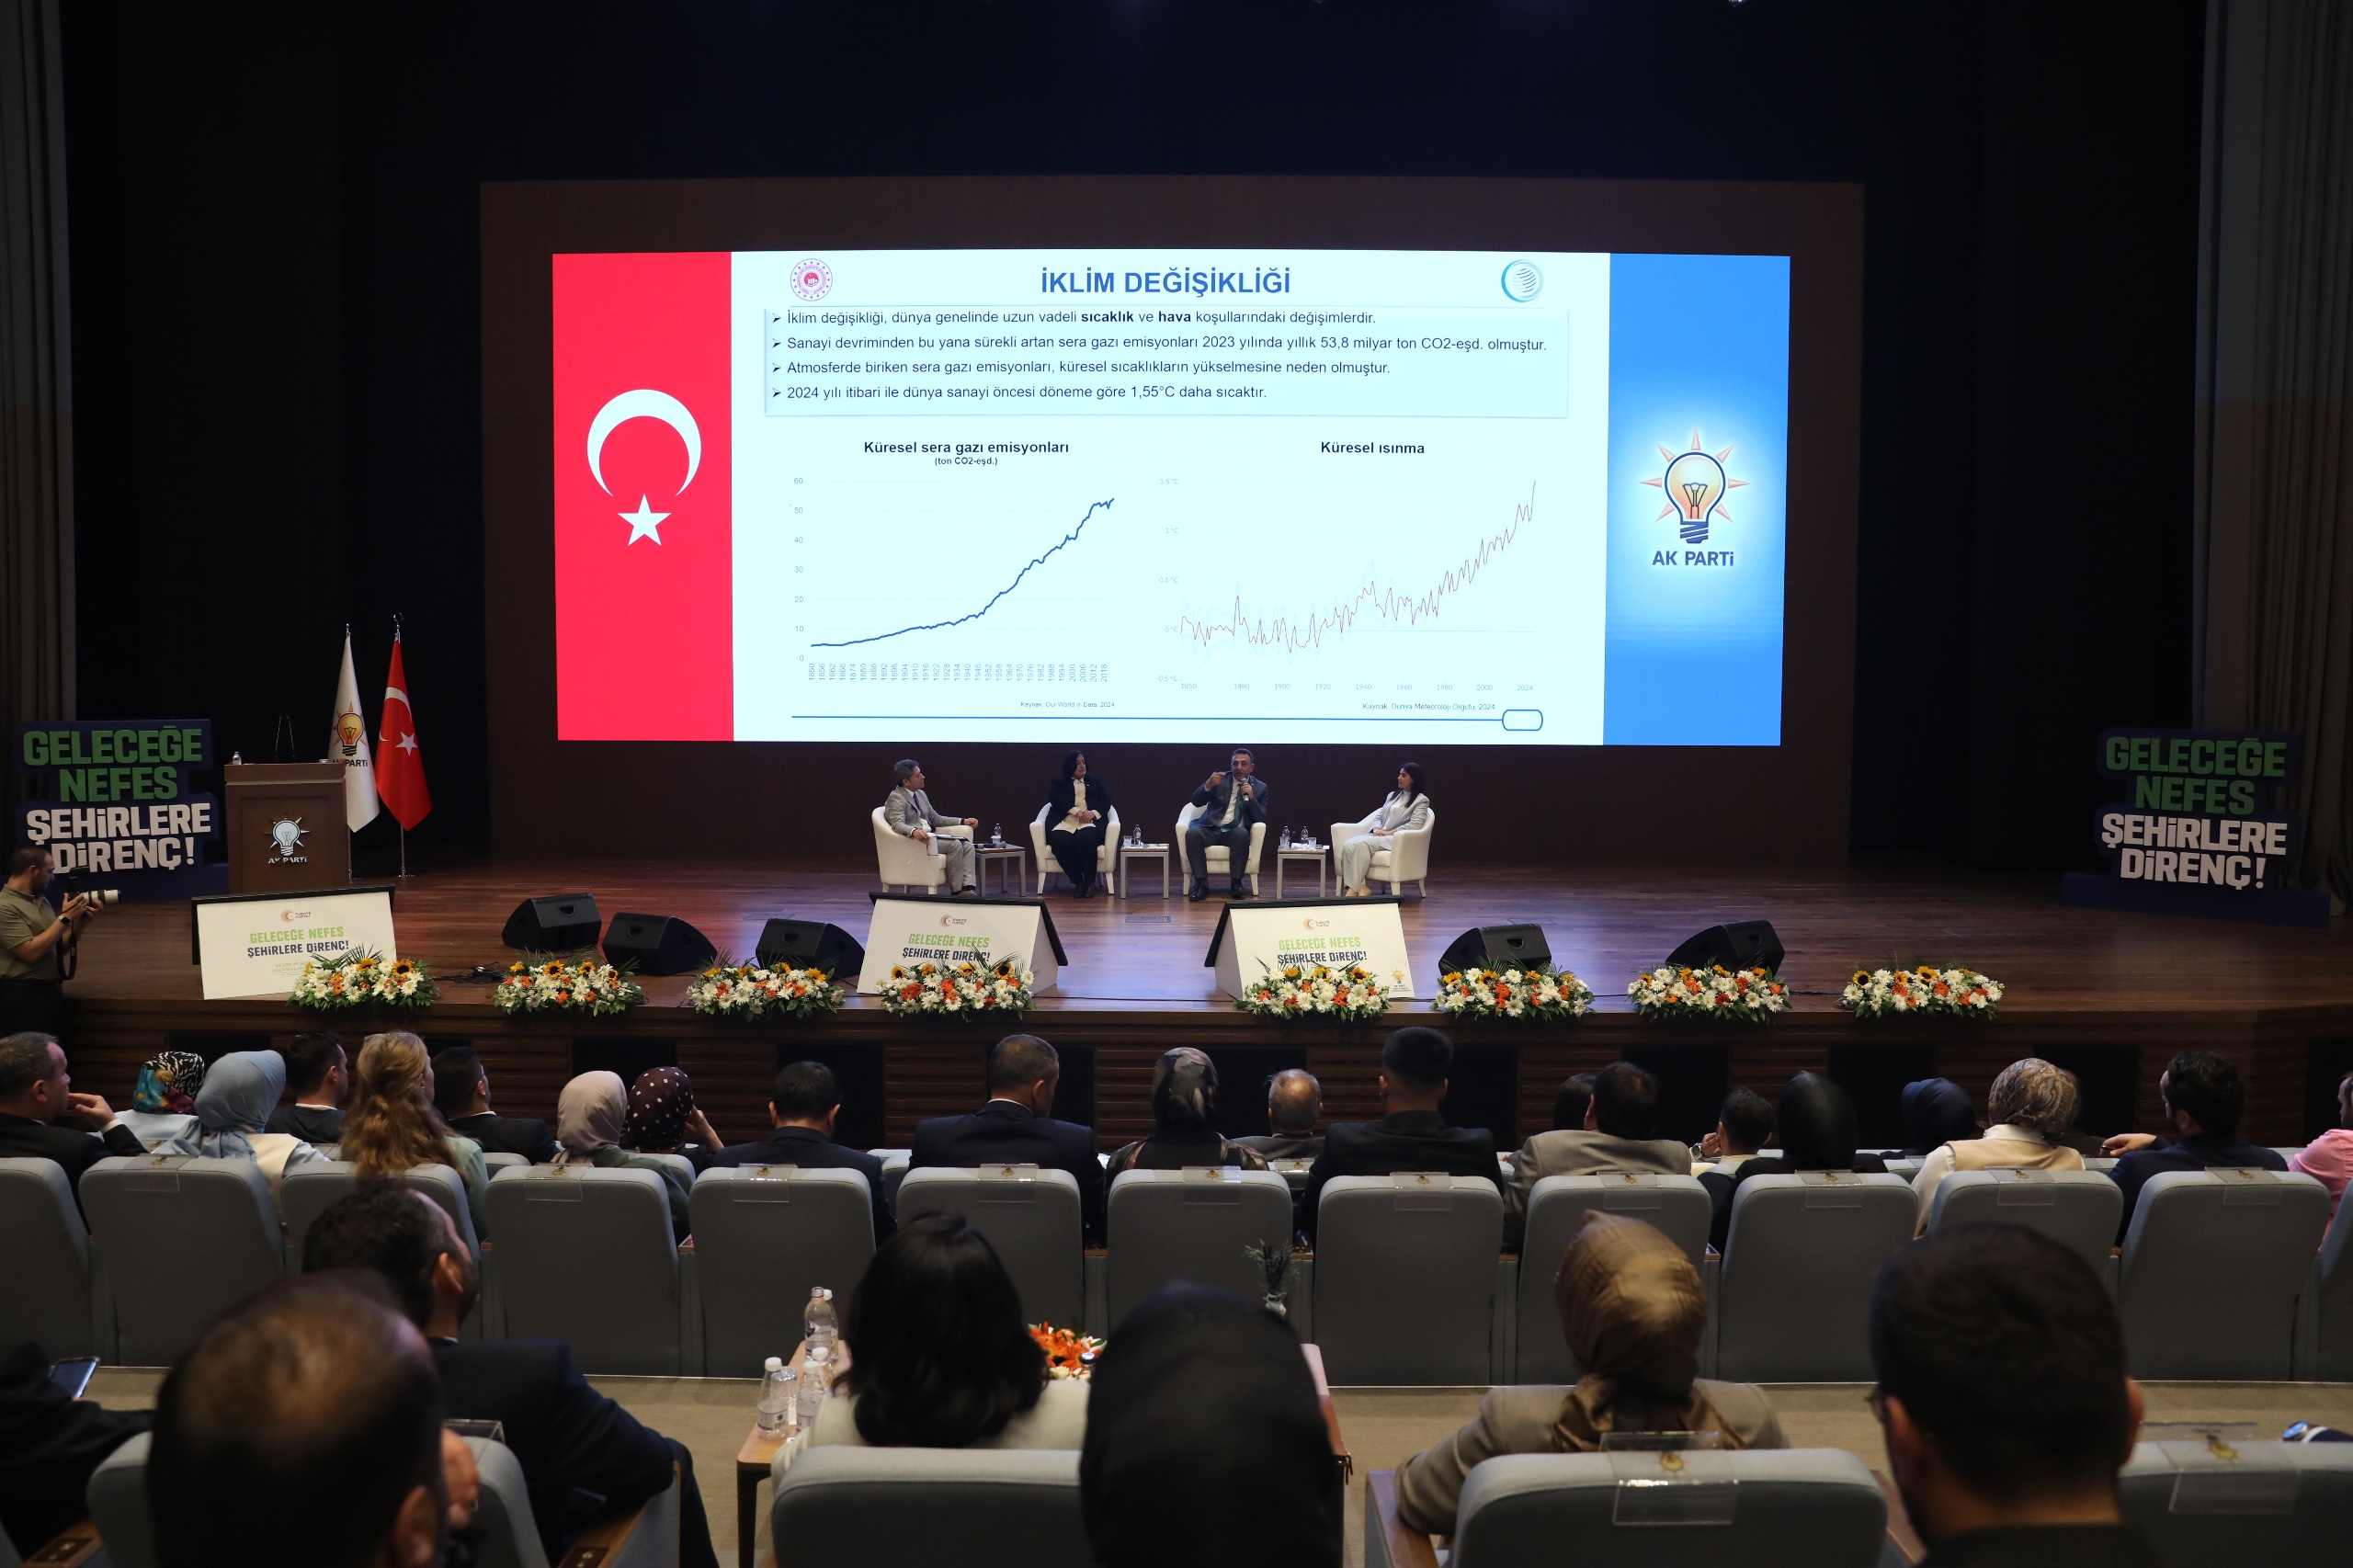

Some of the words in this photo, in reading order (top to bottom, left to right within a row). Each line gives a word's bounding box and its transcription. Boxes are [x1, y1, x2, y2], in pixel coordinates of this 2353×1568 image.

[1041, 267, 1115, 293] İKLİM
[1124, 267, 1290, 299] DEĞİŞİKLİĞİ
[788, 309, 817, 324] İklim
[821, 311, 887, 327] değişikliği,
[892, 311, 931, 326] dünya
[935, 311, 999, 325] genelinde
[1003, 312, 1035, 323] uzun
[1039, 311, 1077, 323] vadeli
[1081, 310, 1135, 323] sıcaklık
[1138, 312, 1154, 323] ve
[1158, 310, 1192, 323] hava
[1196, 311, 1286, 326] koşullarındaki
[1290, 311, 1376, 326] değişimlerdir.
[787, 336, 831, 352] Sanayi
[835, 336, 915, 348] devriminden
[918, 335, 935, 348] bu
[938, 338, 971, 351] yana
[974, 335, 1017, 348] sürekli
[1020, 335, 1054, 347] artan
[1058, 338, 1087, 347] sera
[1091, 338, 1119, 350] gazı
[1122, 335, 1198, 350] emisyonları
[1202, 335, 1235, 348] 2023
[1239, 335, 1283, 351] yılında
[1286, 335, 1317, 351] yıllık
[1320, 336, 1349, 350] 53,8
[1353, 336, 1393, 352] milyar
[1396, 337, 1417, 349] ton
[1421, 337, 1483, 353] CO2-eşd.
[1487, 337, 1547, 354] olmuştur.
[787, 361, 861, 374] Atmosferde
[865, 360, 908, 373] biriken
[912, 363, 940, 373] sera
[944, 363, 972, 376] gazı
[976, 360, 1055, 375] emisyonları,
[1059, 360, 1107, 372] küresel
[1110, 360, 1188, 372] sıcaklıkların
[1192, 360, 1282, 375] yükselmesine
[1286, 360, 1327, 373] neden
[1330, 361, 1391, 377] olmuştur.
[787, 386, 820, 399] 2024
[823, 386, 841, 402] yılı
[846, 386, 881, 398] itibari
[884, 386, 900, 398] ile
[903, 385, 943, 401] dünya
[947, 385, 989, 401] sanayi
[993, 385, 1035, 398] öncesi
[1039, 385, 1093, 398] döneme
[1096, 386, 1126, 401] göre
[1178, 385, 1212, 398] daha
[1216, 385, 1267, 398] sıcaktır.
[864, 441, 917, 453] Küresel
[921, 444, 951, 453] sera
[955, 443, 983, 456] gazı
[987, 440, 1069, 456] emisyonları
[1321, 441, 1374, 454] Küresel
[1379, 444, 1426, 454] ısınma
[793, 506, 804, 515] 50
[793, 536, 804, 544] 40
[1653, 551, 1677, 565] AK
[794, 565, 804, 574] 30
[1436, 683, 1453, 691] 1980
[1476, 683, 1494, 691] 2000
[23, 726, 202, 766] GELECEĞE
[2106, 737, 2287, 777] GELECEĞE
[59, 767, 177, 802] NEFES
[2135, 776, 2255, 815] NEFES
[249, 928, 304, 943] GELECEĞE
[309, 926, 344, 938] NEFES
[908, 933, 955, 946] GELECEĞE
[959, 937, 990, 948] NEFES
[1279, 937, 1326, 950] GELECEĞE
[1329, 937, 1361, 948] NEFES
